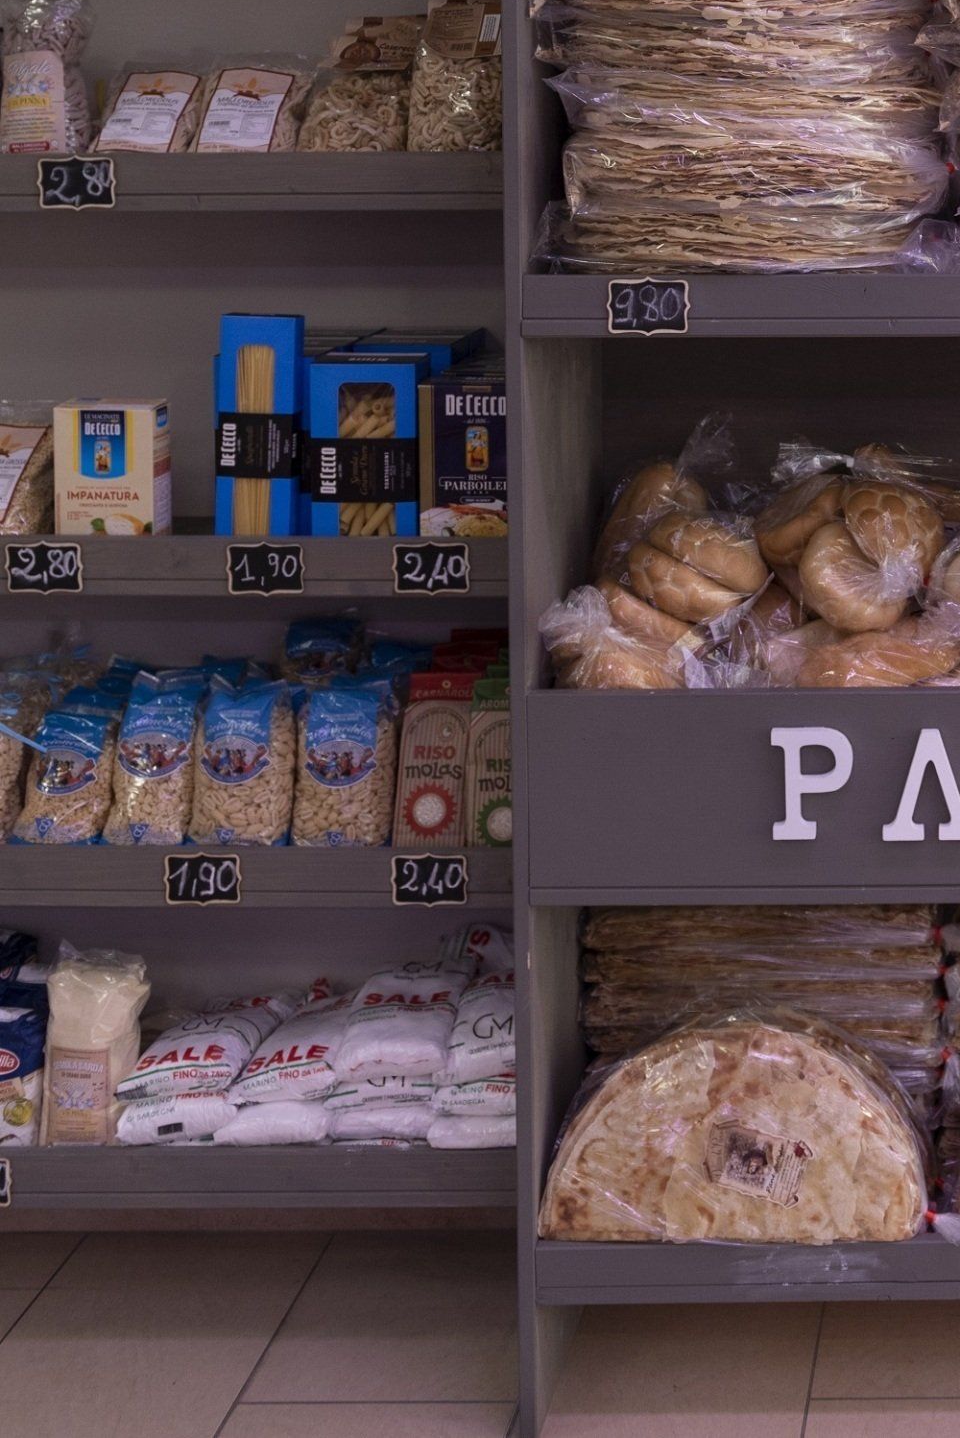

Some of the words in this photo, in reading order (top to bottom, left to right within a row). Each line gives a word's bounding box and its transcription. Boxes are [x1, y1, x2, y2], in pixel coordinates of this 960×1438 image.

[66, 490, 140, 502] IMPANATURA
[12, 548, 77, 582] 2,80
[402, 551, 466, 588] 2,40
[413, 745, 456, 761] RISO
[405, 761, 463, 780] molas
[169, 859, 237, 898] 1,90
[402, 861, 462, 893] 2,40
[363, 991, 453, 1006] SALE
[136, 1043, 227, 1072] SALE
[246, 1044, 330, 1074] SALE
[172, 1069, 199, 1081] FINO
[279, 1069, 300, 1080] FINO
[484, 1084, 511, 1094] FINO
